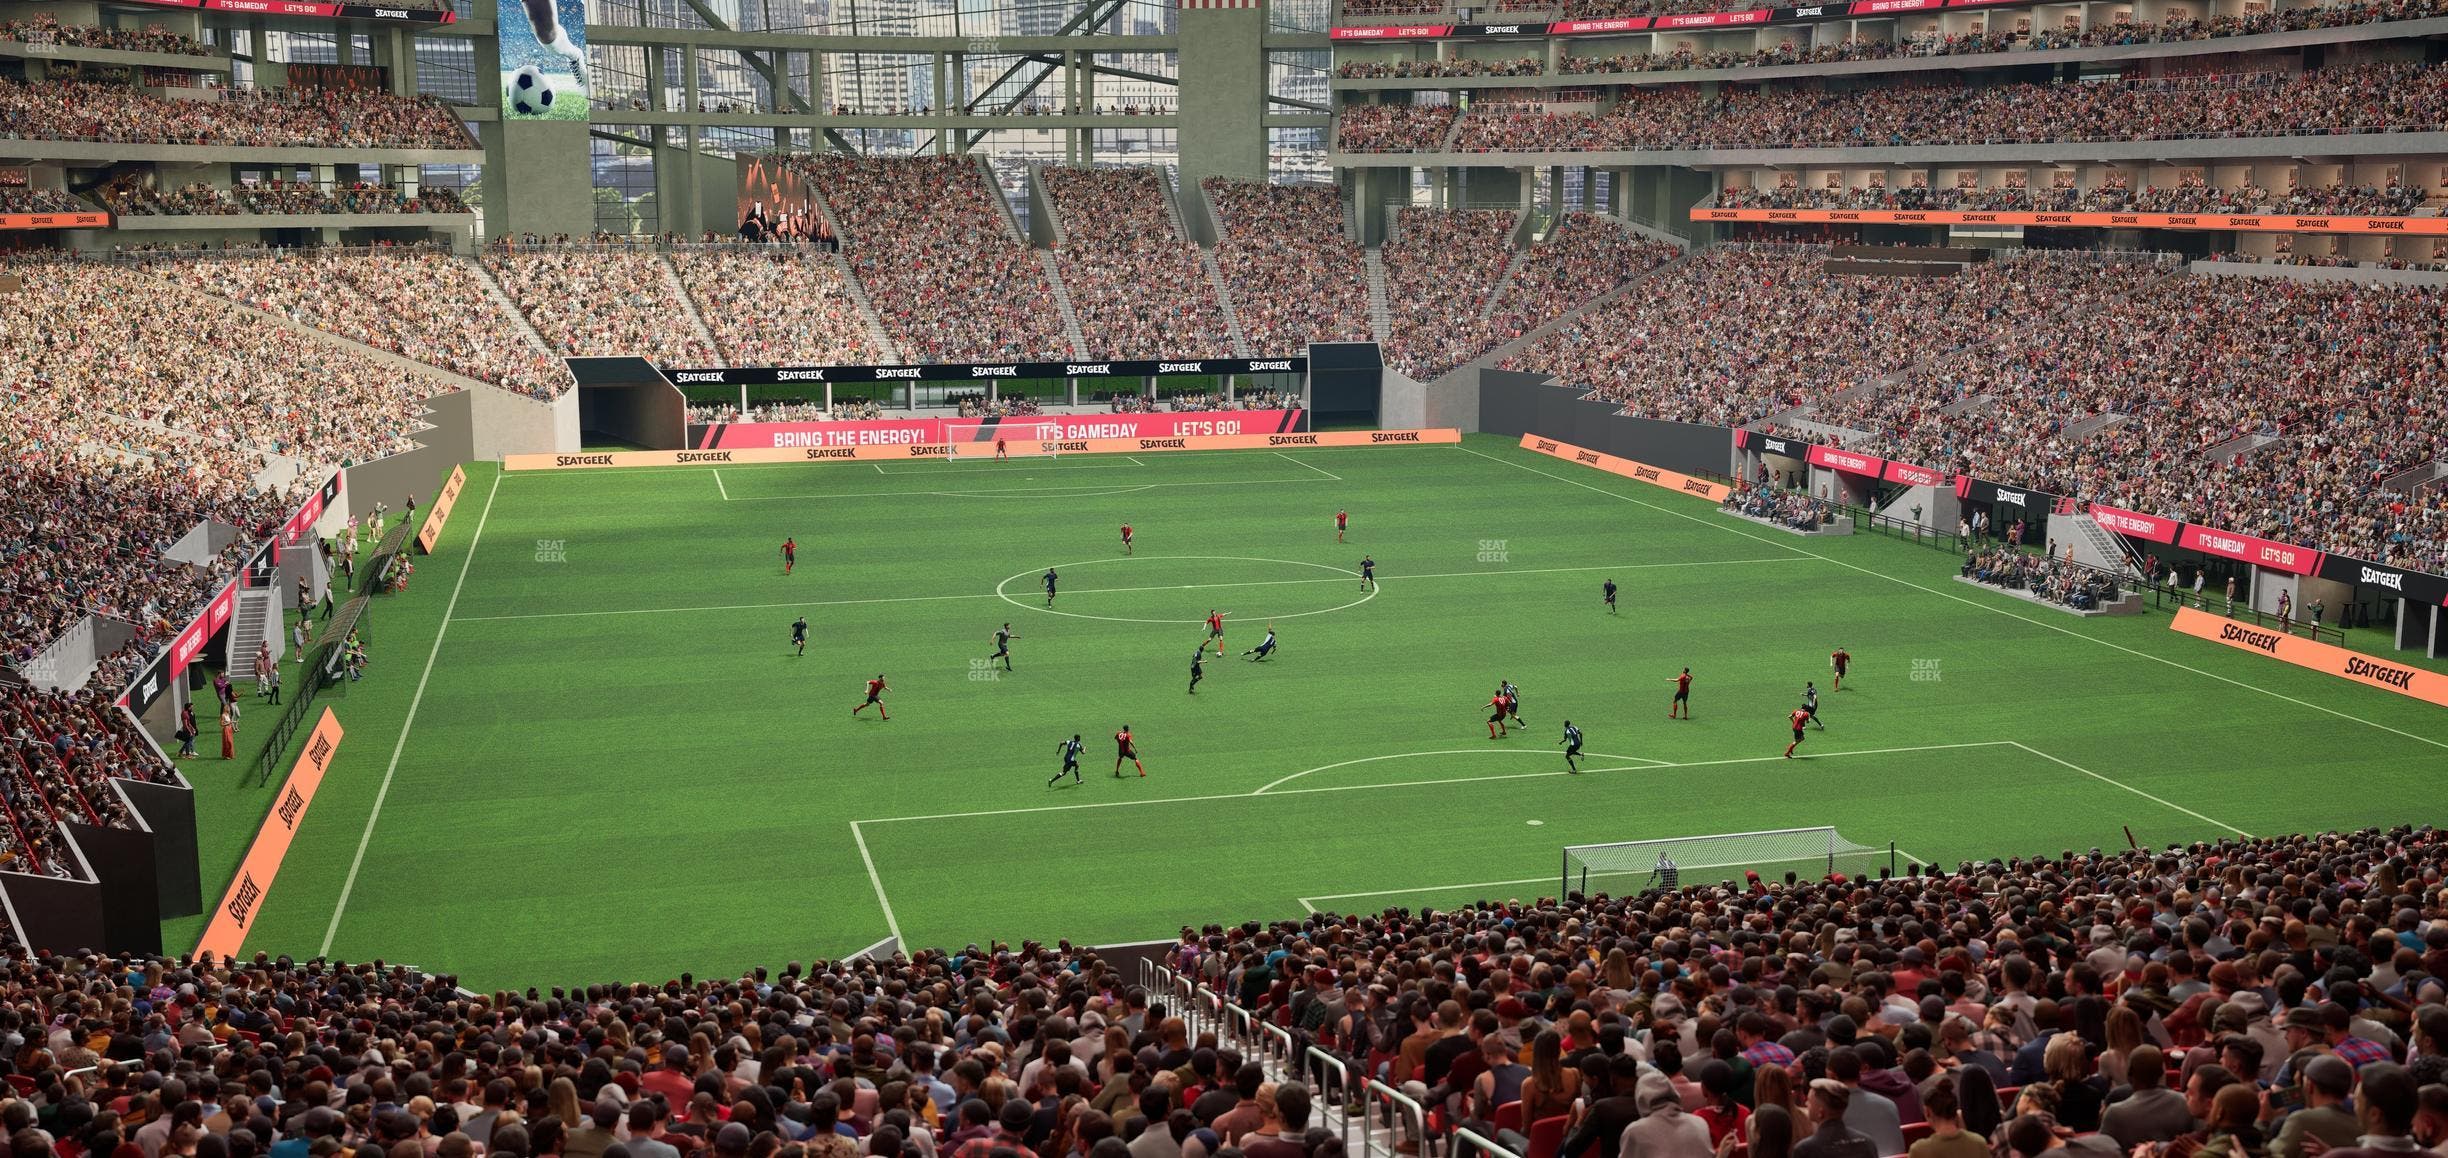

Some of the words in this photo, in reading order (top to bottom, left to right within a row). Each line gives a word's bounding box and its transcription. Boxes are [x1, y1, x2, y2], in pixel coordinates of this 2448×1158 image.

[234, 1, 268, 10] GAMEDAY
[284, 4, 303, 12] LET'S
[1796, 6, 1823, 17] SEATGEEK
[375, 9, 408, 19] SEATGEEK
[1572, 23, 1591, 31] BRING
[1592, 22, 1603, 30] THE
[1685, 16, 1715, 25] GAMEDAY
[1353, 29, 1385, 37] GAMEDAY
[1398, 28, 1416, 36] LET'S
[1485, 25, 1519, 34] SEATGEEK
[1710, 211, 1738, 219] SEATGEEK
[1768, 211, 1797, 219] SEATGEEK
[1829, 212, 1860, 220] SEATGEEK
[1893, 213, 1926, 221] SEATGEEK
[1962, 214, 1996, 222] SEATGEEK
[2035, 215, 2072, 223] SEATGEEK
[2111, 215, 2138, 224] SEATGEEK
[2168, 216, 2197, 226] SEATGEEK
[2229, 217, 2260, 227] SEATGEEK
[2296, 218, 2330, 228] SEATGEEK
[2368, 220, 2405, 230] SEATGEEK
[972, 366, 1017, 377] SEATGEEK
[1066, 363, 1110, 375] SEATGEEK
[1159, 361, 1202, 373] SEATGEEK
[1249, 360, 1292, 371] SEATGEEK
[676, 372, 725, 383] SEATGEEK
[777, 370, 824, 381] SEATGEEK
[875, 367, 922, 379] SEATGEEK
[1036, 425, 1064, 440] IT'S
[1067, 423, 1138, 439] GAMEDAY
[1173, 421, 1213, 437] LET'S
[1216, 420, 1241, 435] GO!
[773, 430, 823, 448] BRING
[826, 430, 857, 446] THE
[859, 428, 925, 446] ENERGY!
[1269, 434, 1318, 446] SEATGEEK
[1371, 431, 1420, 443] SEATGEEK
[1140, 438, 1186, 449] SEATGEEK
[1536, 440, 1559, 454] SEATGEEK
[1765, 438, 1786, 454] SEATGEEK
[807, 447, 856, 459] SEATGEEK
[910, 444, 958, 456] SEATGEEK
[556, 454, 613, 466] SEATGEEK
[676, 451, 732, 463] SEATGEEK
[1576, 450, 1601, 466] SEATGEEK
[1634, 465, 1661, 482] SEATGEEK
[1683, 479, 1713, 497] SEATGEEK
[1997, 488, 2026, 507] SEATGEEK
[2117, 516, 2128, 529] THE
[2129, 518, 2155, 535] ENERGY!
[2199, 533, 2212, 549] IT'S
[2212, 536, 2246, 556] GAMEDAY
[2261, 547, 2281, 563] LET'S
[2281, 551, 2296, 567] GO!
[2361, 566, 2403, 591] SEATGEEK
[2220, 623, 2282, 653] SEATGEEK
[2344, 656, 2415, 691] SEATGEEK
[309, 730, 332, 771] SEATGEEK
[278, 783, 305, 830] SEATGEEK
[228, 870, 261, 930] SEATGEEK
